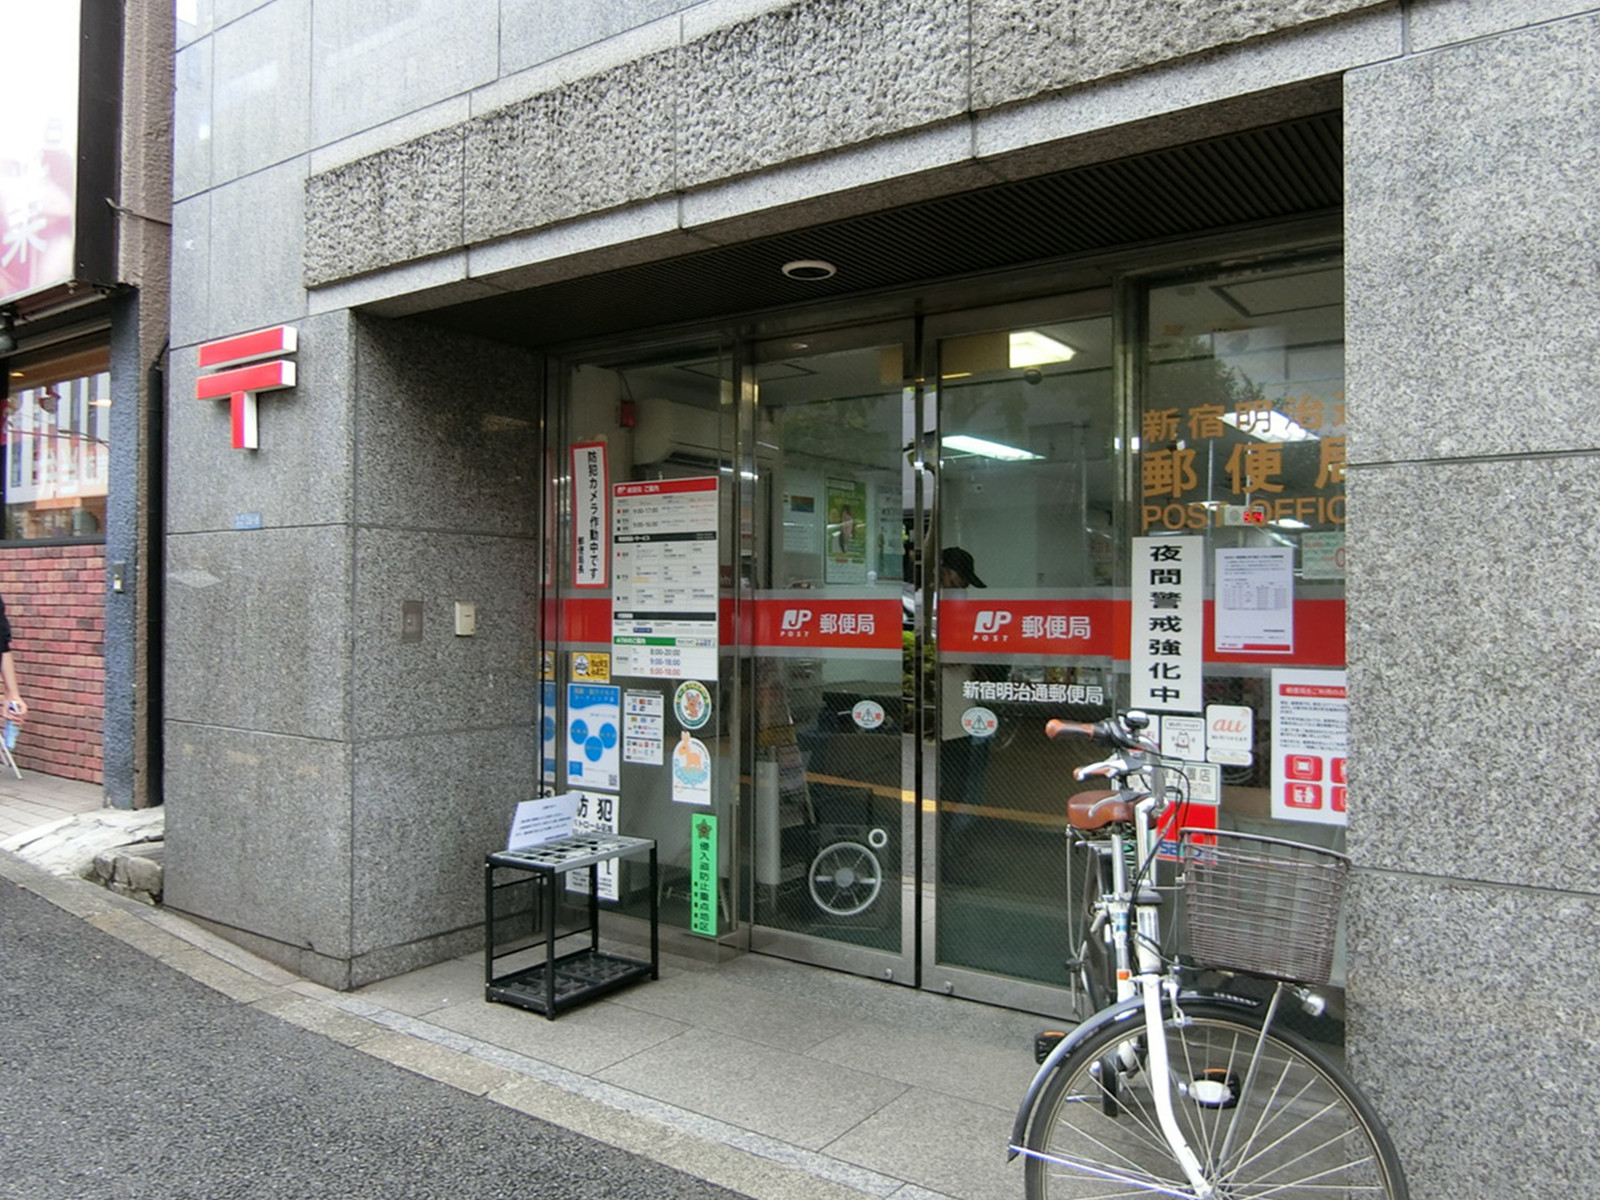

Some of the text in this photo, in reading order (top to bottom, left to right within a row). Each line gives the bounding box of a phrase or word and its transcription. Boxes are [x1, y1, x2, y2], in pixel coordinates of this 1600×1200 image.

[1143, 394, 1346, 443] 新宿明治
[587, 450, 599, 580] 防犯カメラ作動中です
[1141, 502, 1229, 532] POST
[820, 613, 875, 635] 郵便局
[1022, 615, 1091, 640] 郵便局
[1149, 545, 1182, 703] 夜間警戒強化中
[963, 680, 1104, 705] 新宿明治通郵便局
[1212, 718, 1246, 733] au
